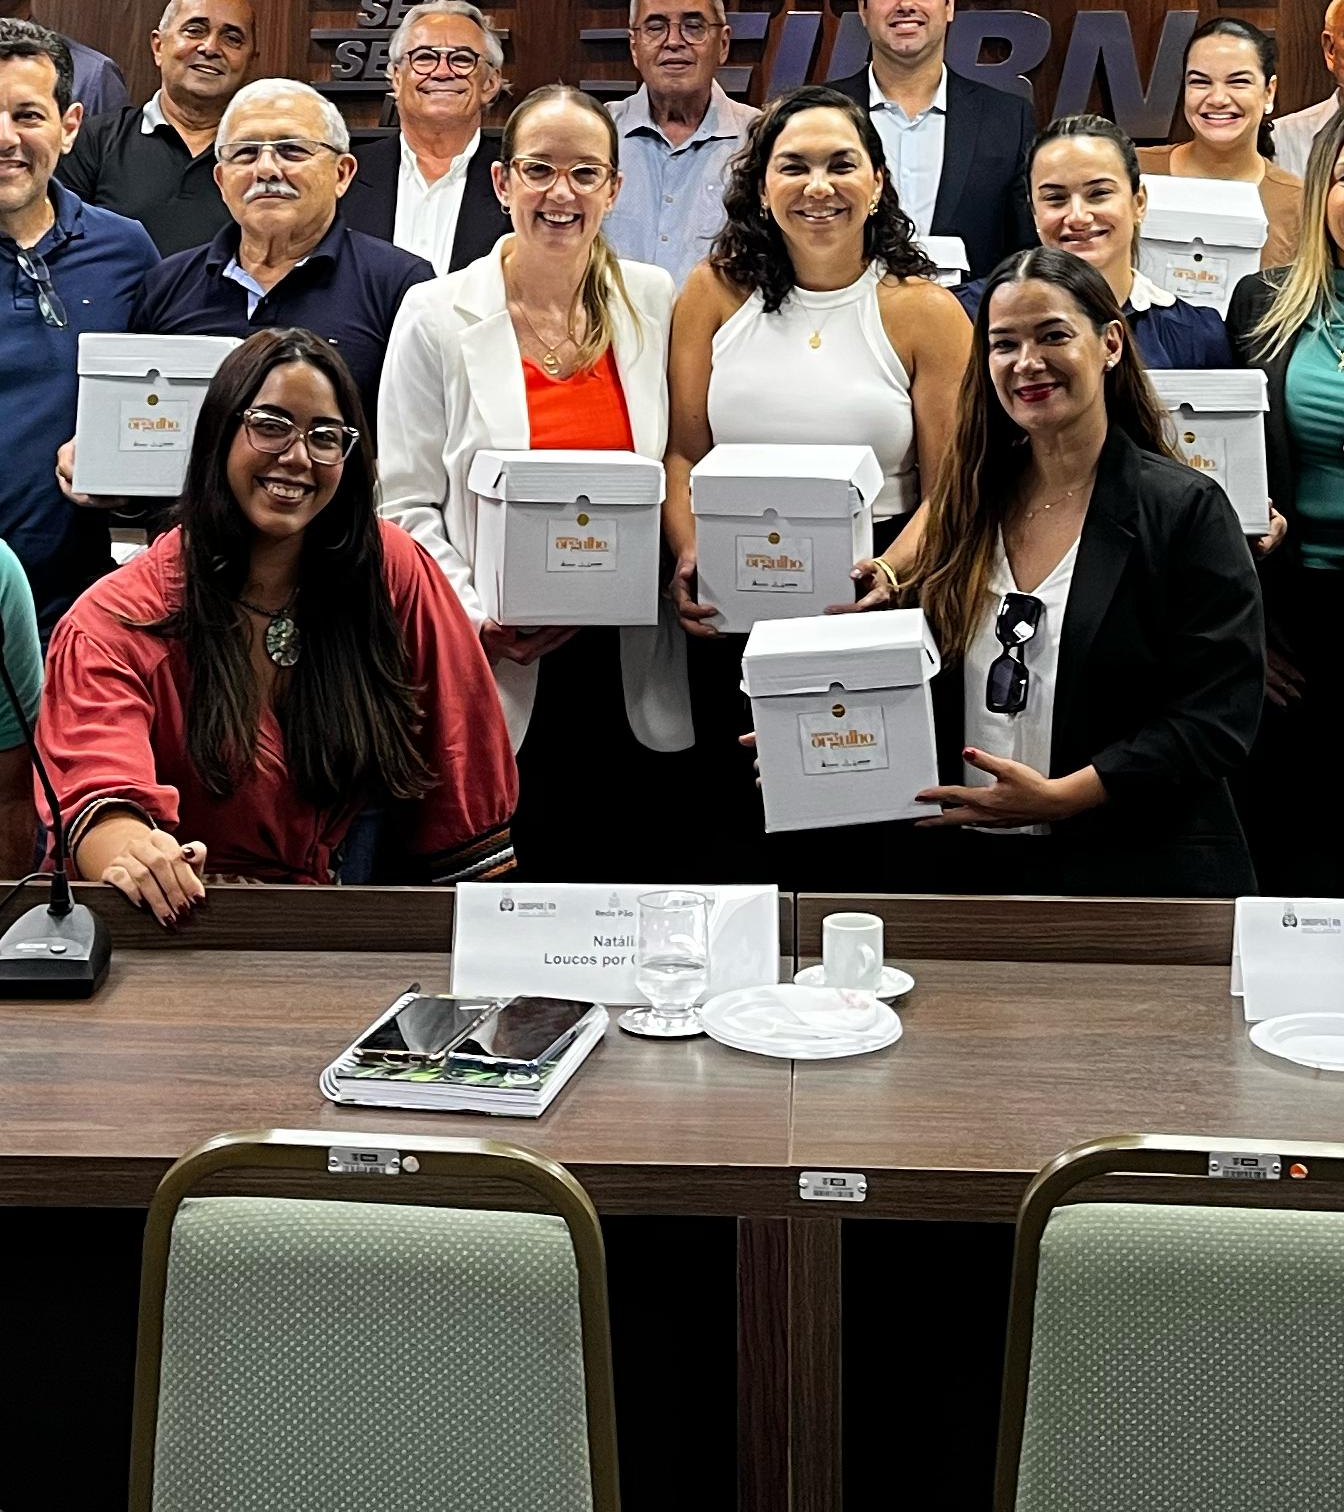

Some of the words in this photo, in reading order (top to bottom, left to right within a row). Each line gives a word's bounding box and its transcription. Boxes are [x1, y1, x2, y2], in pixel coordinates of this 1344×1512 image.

[593, 935, 636, 948] Natáli
[544, 952, 598, 966] Loucos
[602, 955, 627, 967] por
